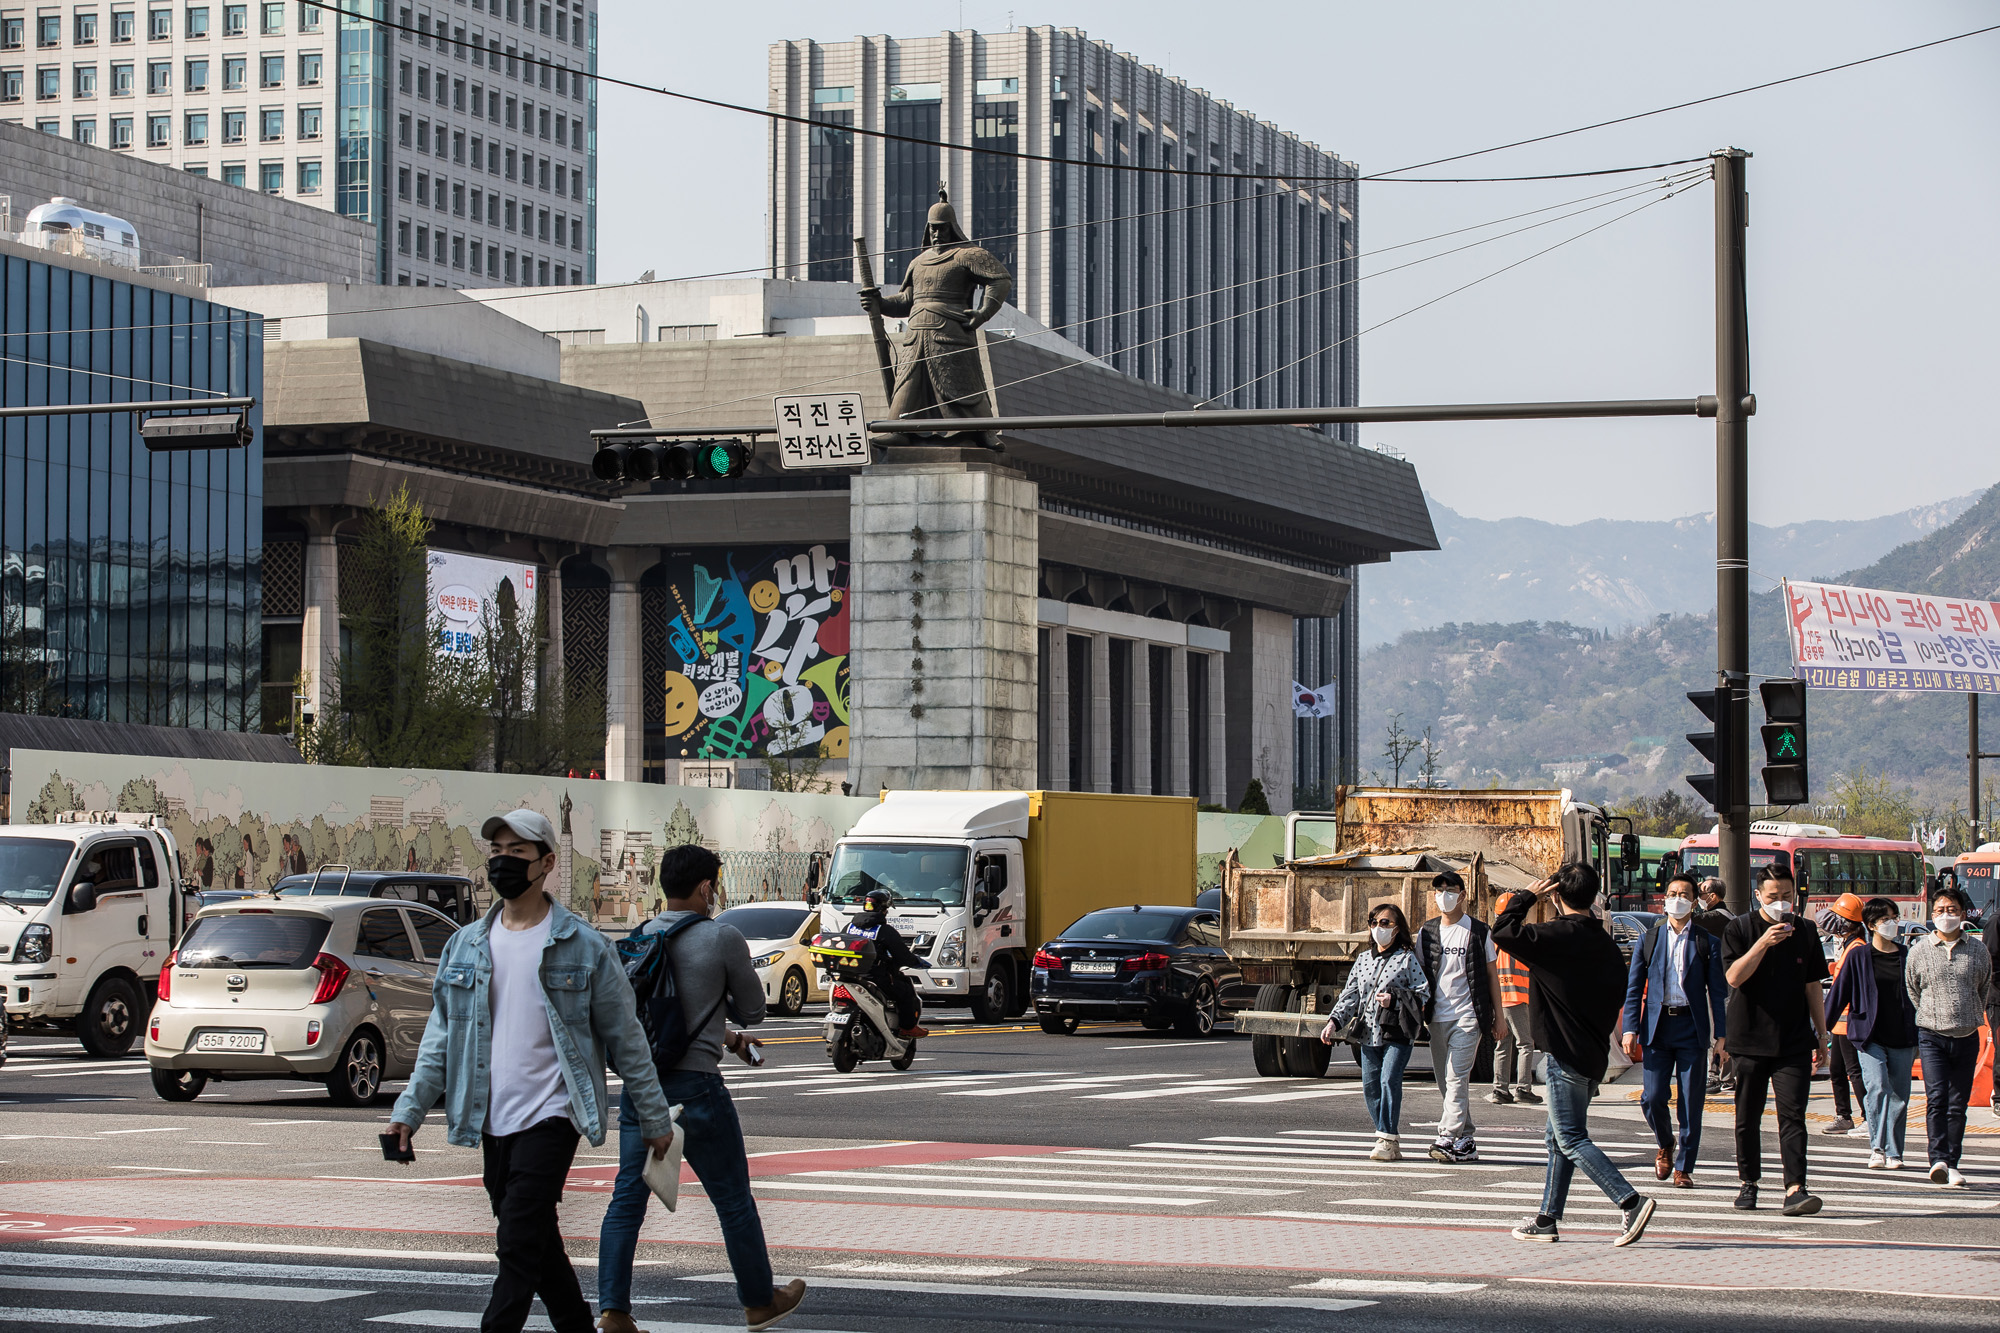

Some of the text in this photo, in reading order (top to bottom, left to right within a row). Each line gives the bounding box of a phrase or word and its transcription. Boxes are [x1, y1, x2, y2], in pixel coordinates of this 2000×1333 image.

[784, 432, 866, 460] 직좌신호
[440, 594, 479, 613] 어려운 이웃 찾는
[670, 583, 710, 660] 2021 Sejong Season
[682, 717, 709, 743] See you
[1966, 867, 1991, 877] 9401
[1092, 963, 1112, 971] 6600
[229, 1035, 257, 1048] 9200
